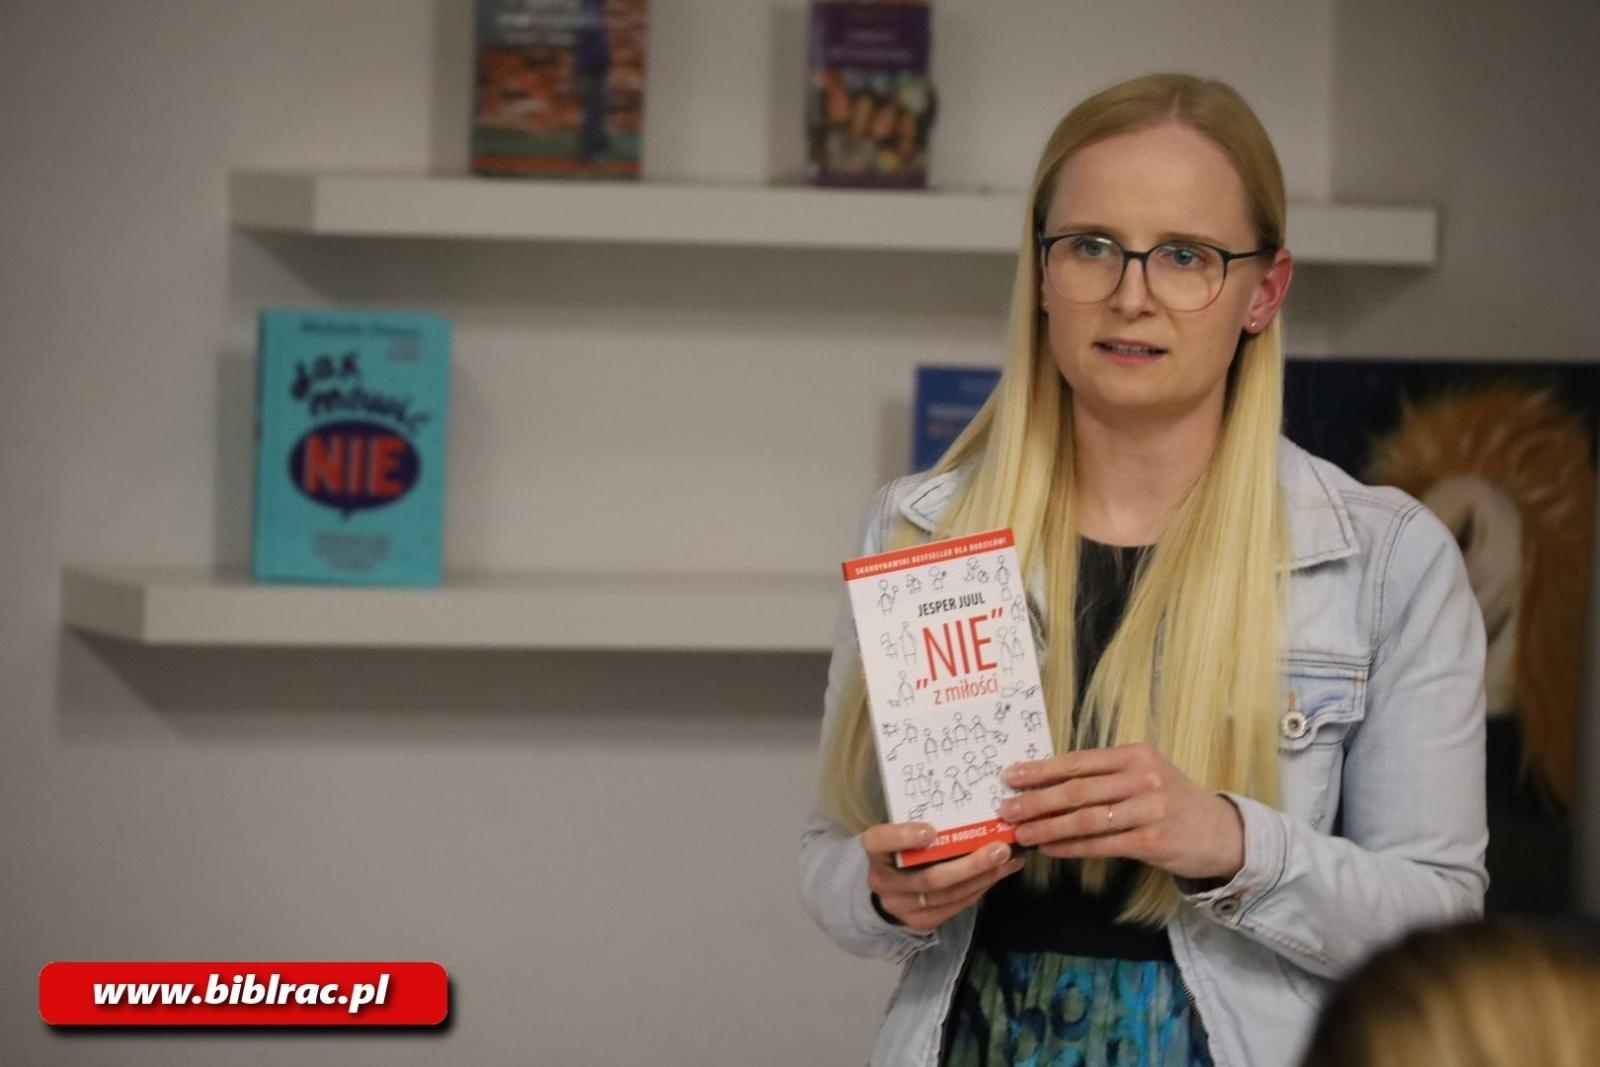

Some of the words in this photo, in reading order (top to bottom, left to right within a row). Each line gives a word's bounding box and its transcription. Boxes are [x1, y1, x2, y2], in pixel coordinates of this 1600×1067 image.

[304, 434, 408, 496] NIE
[911, 549, 952, 563] BESTSELLER
[954, 545, 968, 556] DLA
[918, 598, 956, 617] JESPER
[959, 592, 985, 608] JUUL
[933, 690, 942, 705] z
[945, 673, 998, 702] miłości
[951, 826, 988, 843] RODZICE
